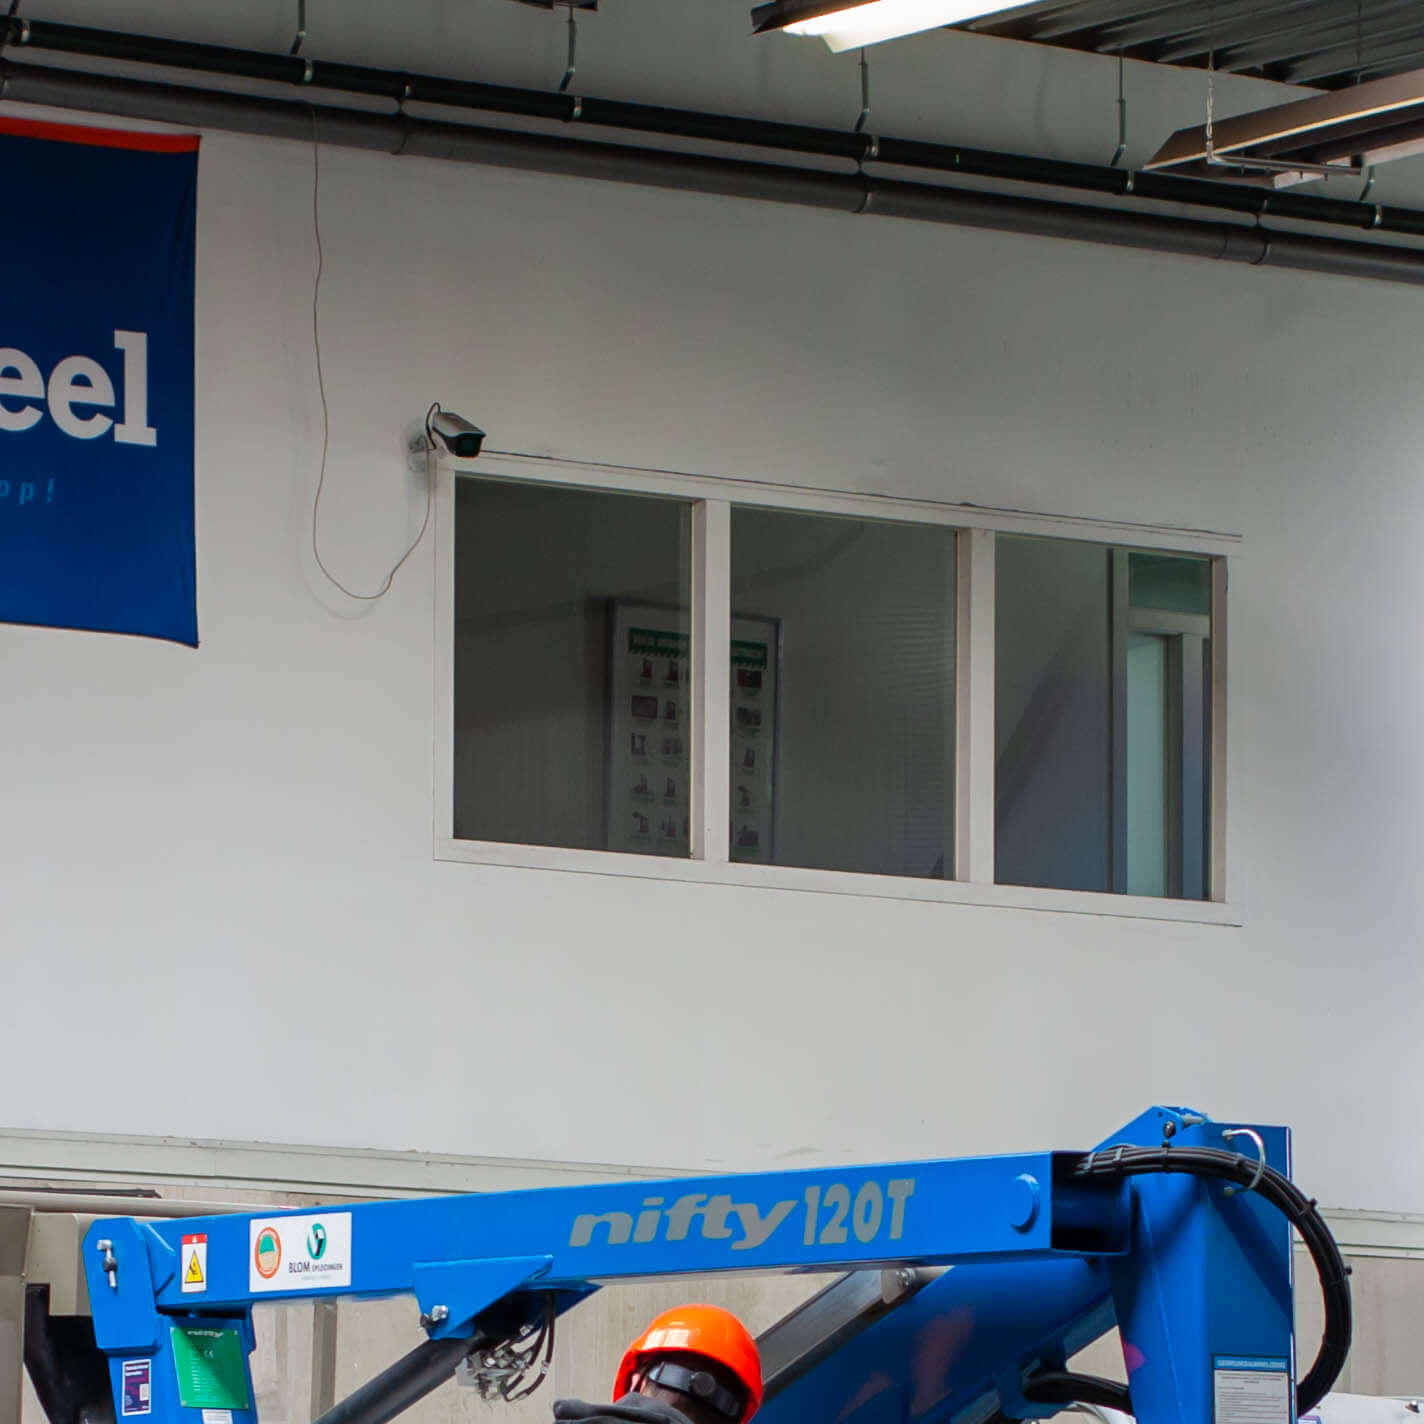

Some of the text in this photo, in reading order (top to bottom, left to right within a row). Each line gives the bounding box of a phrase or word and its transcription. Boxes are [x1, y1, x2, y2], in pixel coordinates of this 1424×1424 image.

[569, 1178, 916, 1250] nifty 120T
[288, 1261, 310, 1273] BLOM
